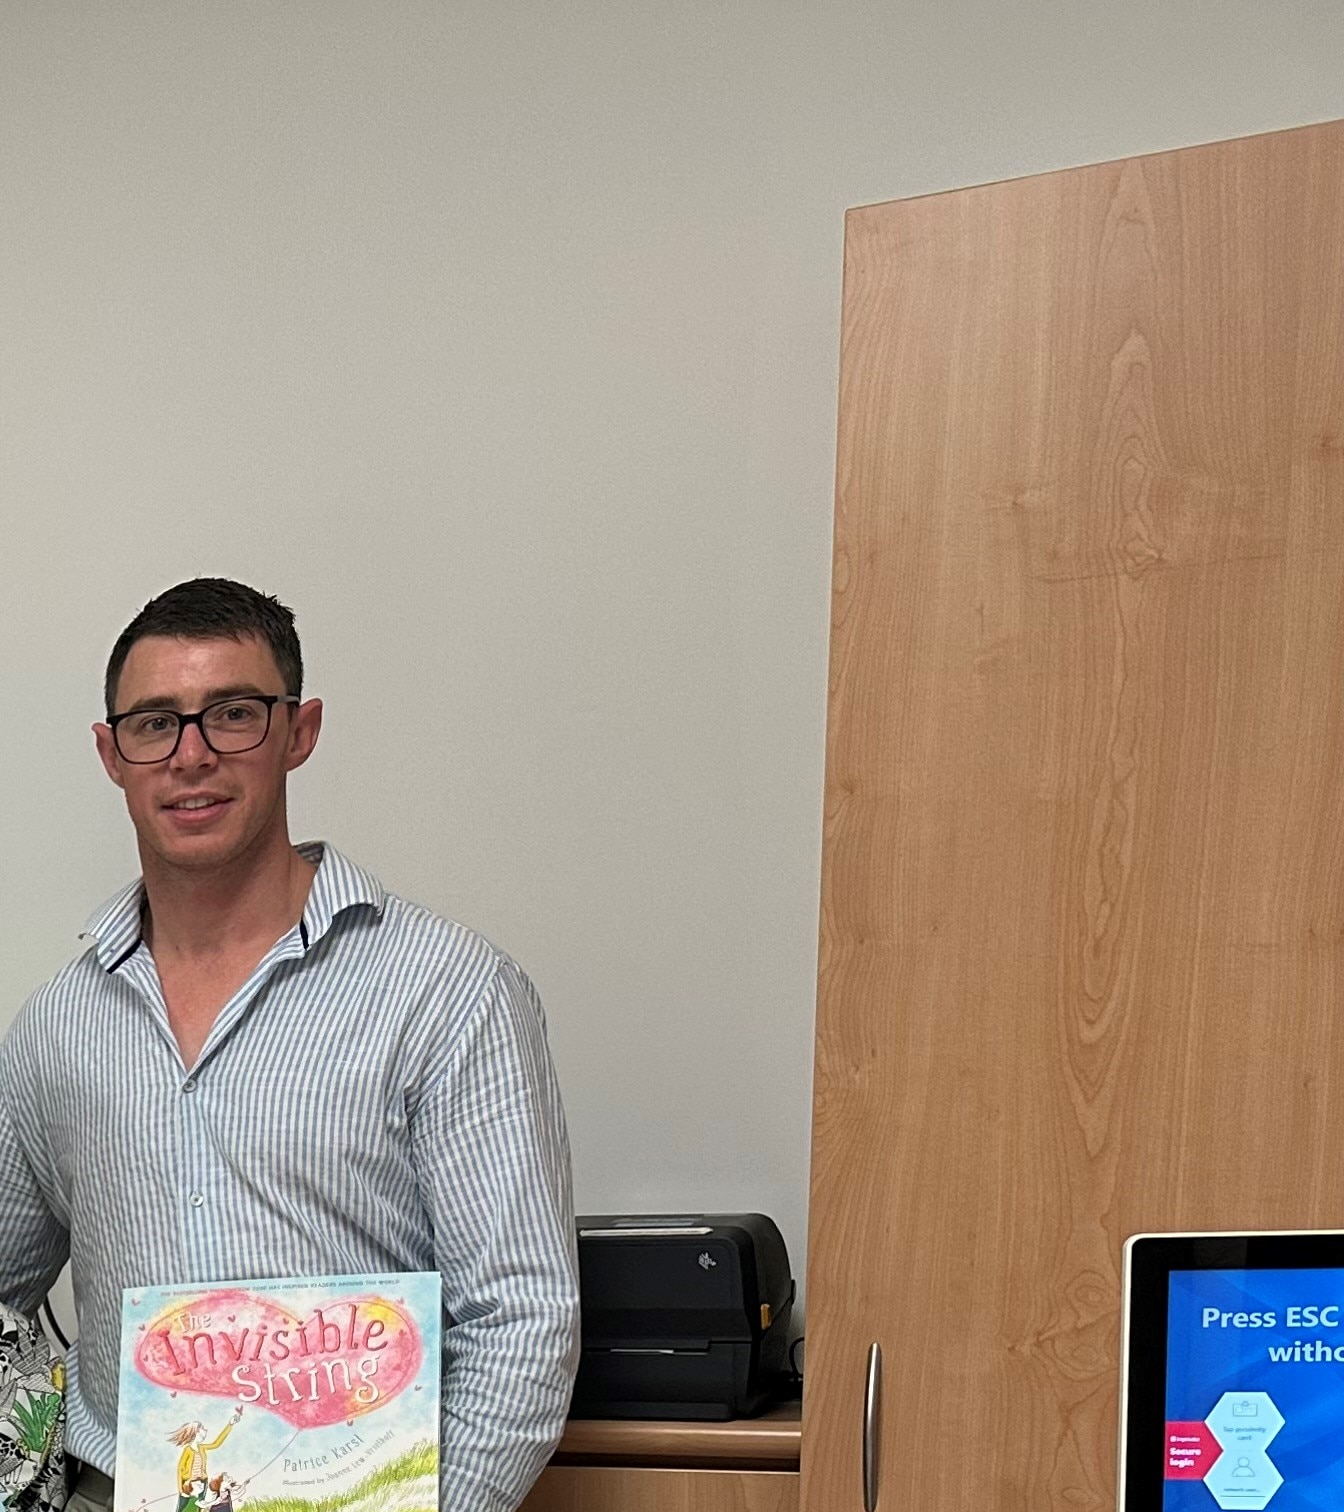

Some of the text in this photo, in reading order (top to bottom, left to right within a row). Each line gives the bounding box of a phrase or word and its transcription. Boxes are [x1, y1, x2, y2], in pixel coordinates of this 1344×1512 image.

[172, 1311, 212, 1334] The
[1202, 1306, 1339, 1328] Press ESC
[162, 1304, 389, 1376] Invisible
[231, 1354, 381, 1406] String
[283, 1434, 364, 1472] Patrice Karst
[1169, 1458, 1194, 1468] login
